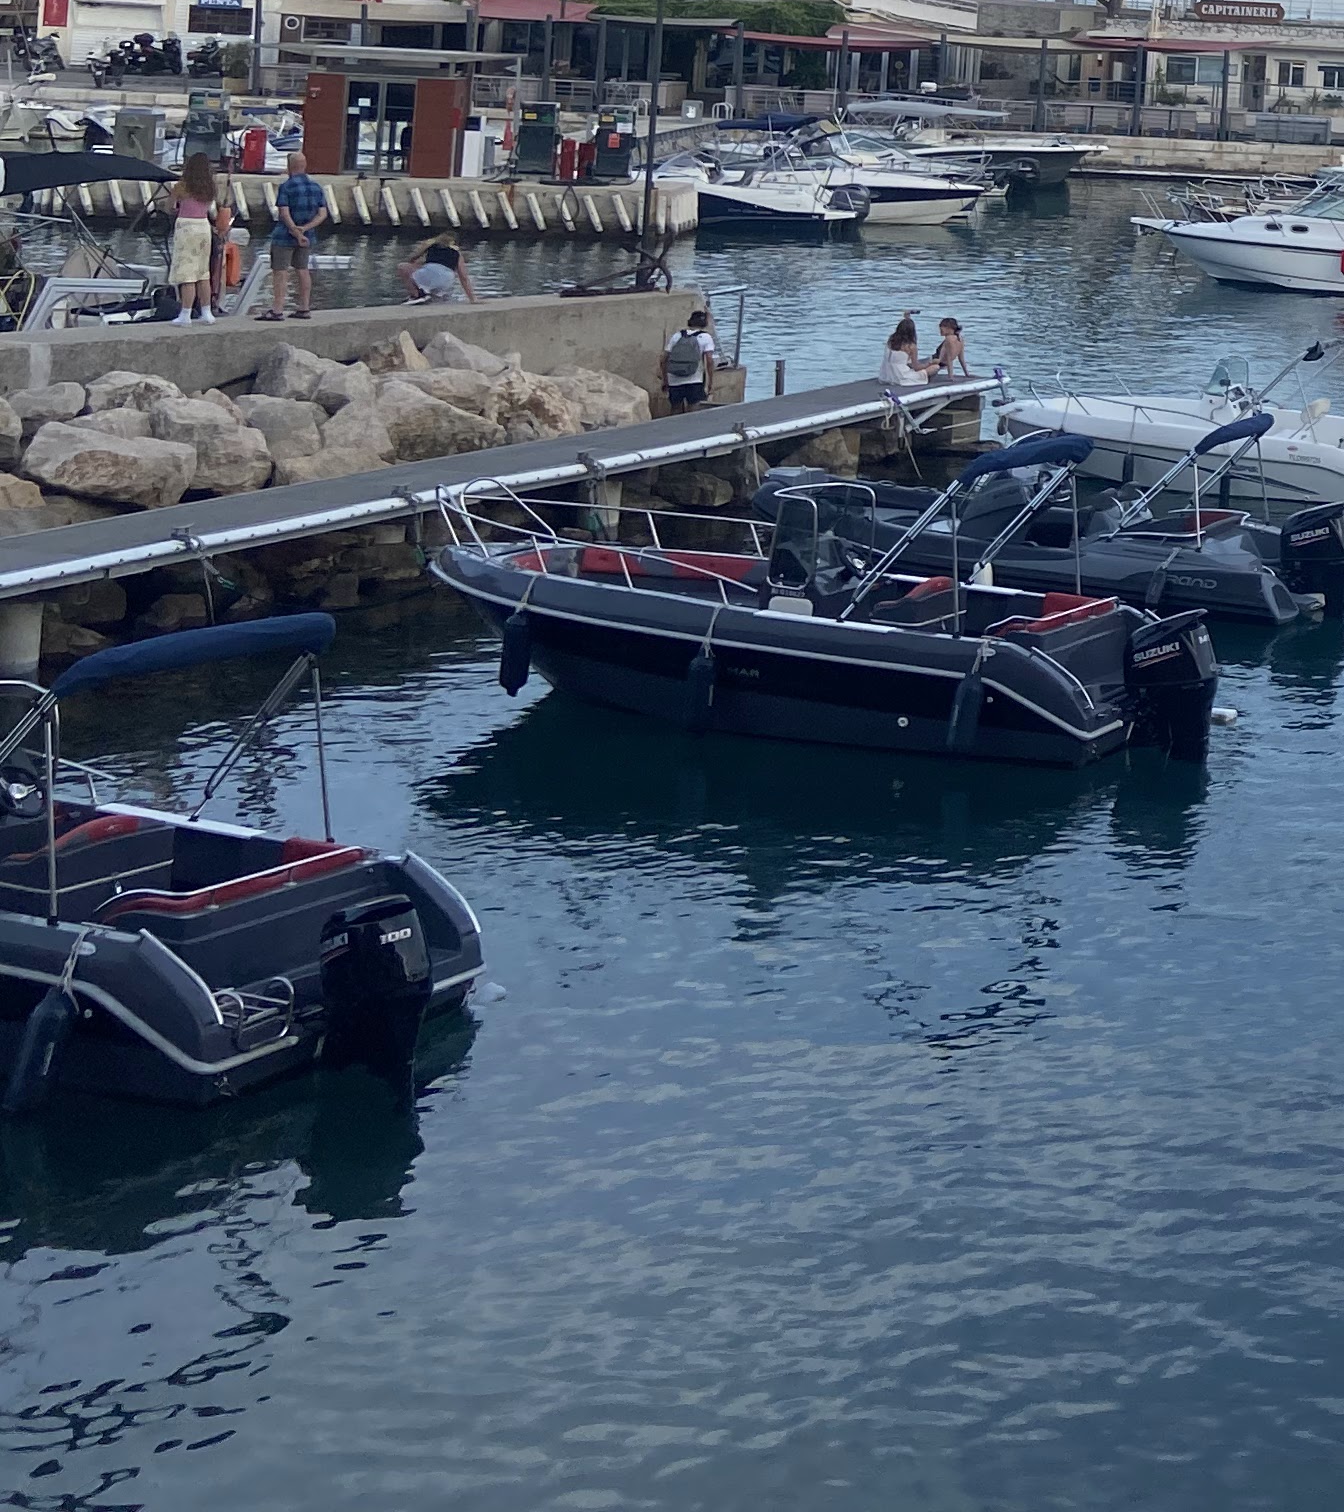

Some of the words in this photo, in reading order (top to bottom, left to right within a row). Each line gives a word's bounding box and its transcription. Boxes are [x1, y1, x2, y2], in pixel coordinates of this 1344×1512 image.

[1201, 4, 1278, 18] CAPITAINERIE
[1290, 527, 1330, 542] SUZUKI
[1133, 641, 1180, 662] SUZUKI
[380, 928, 412, 945] 100
